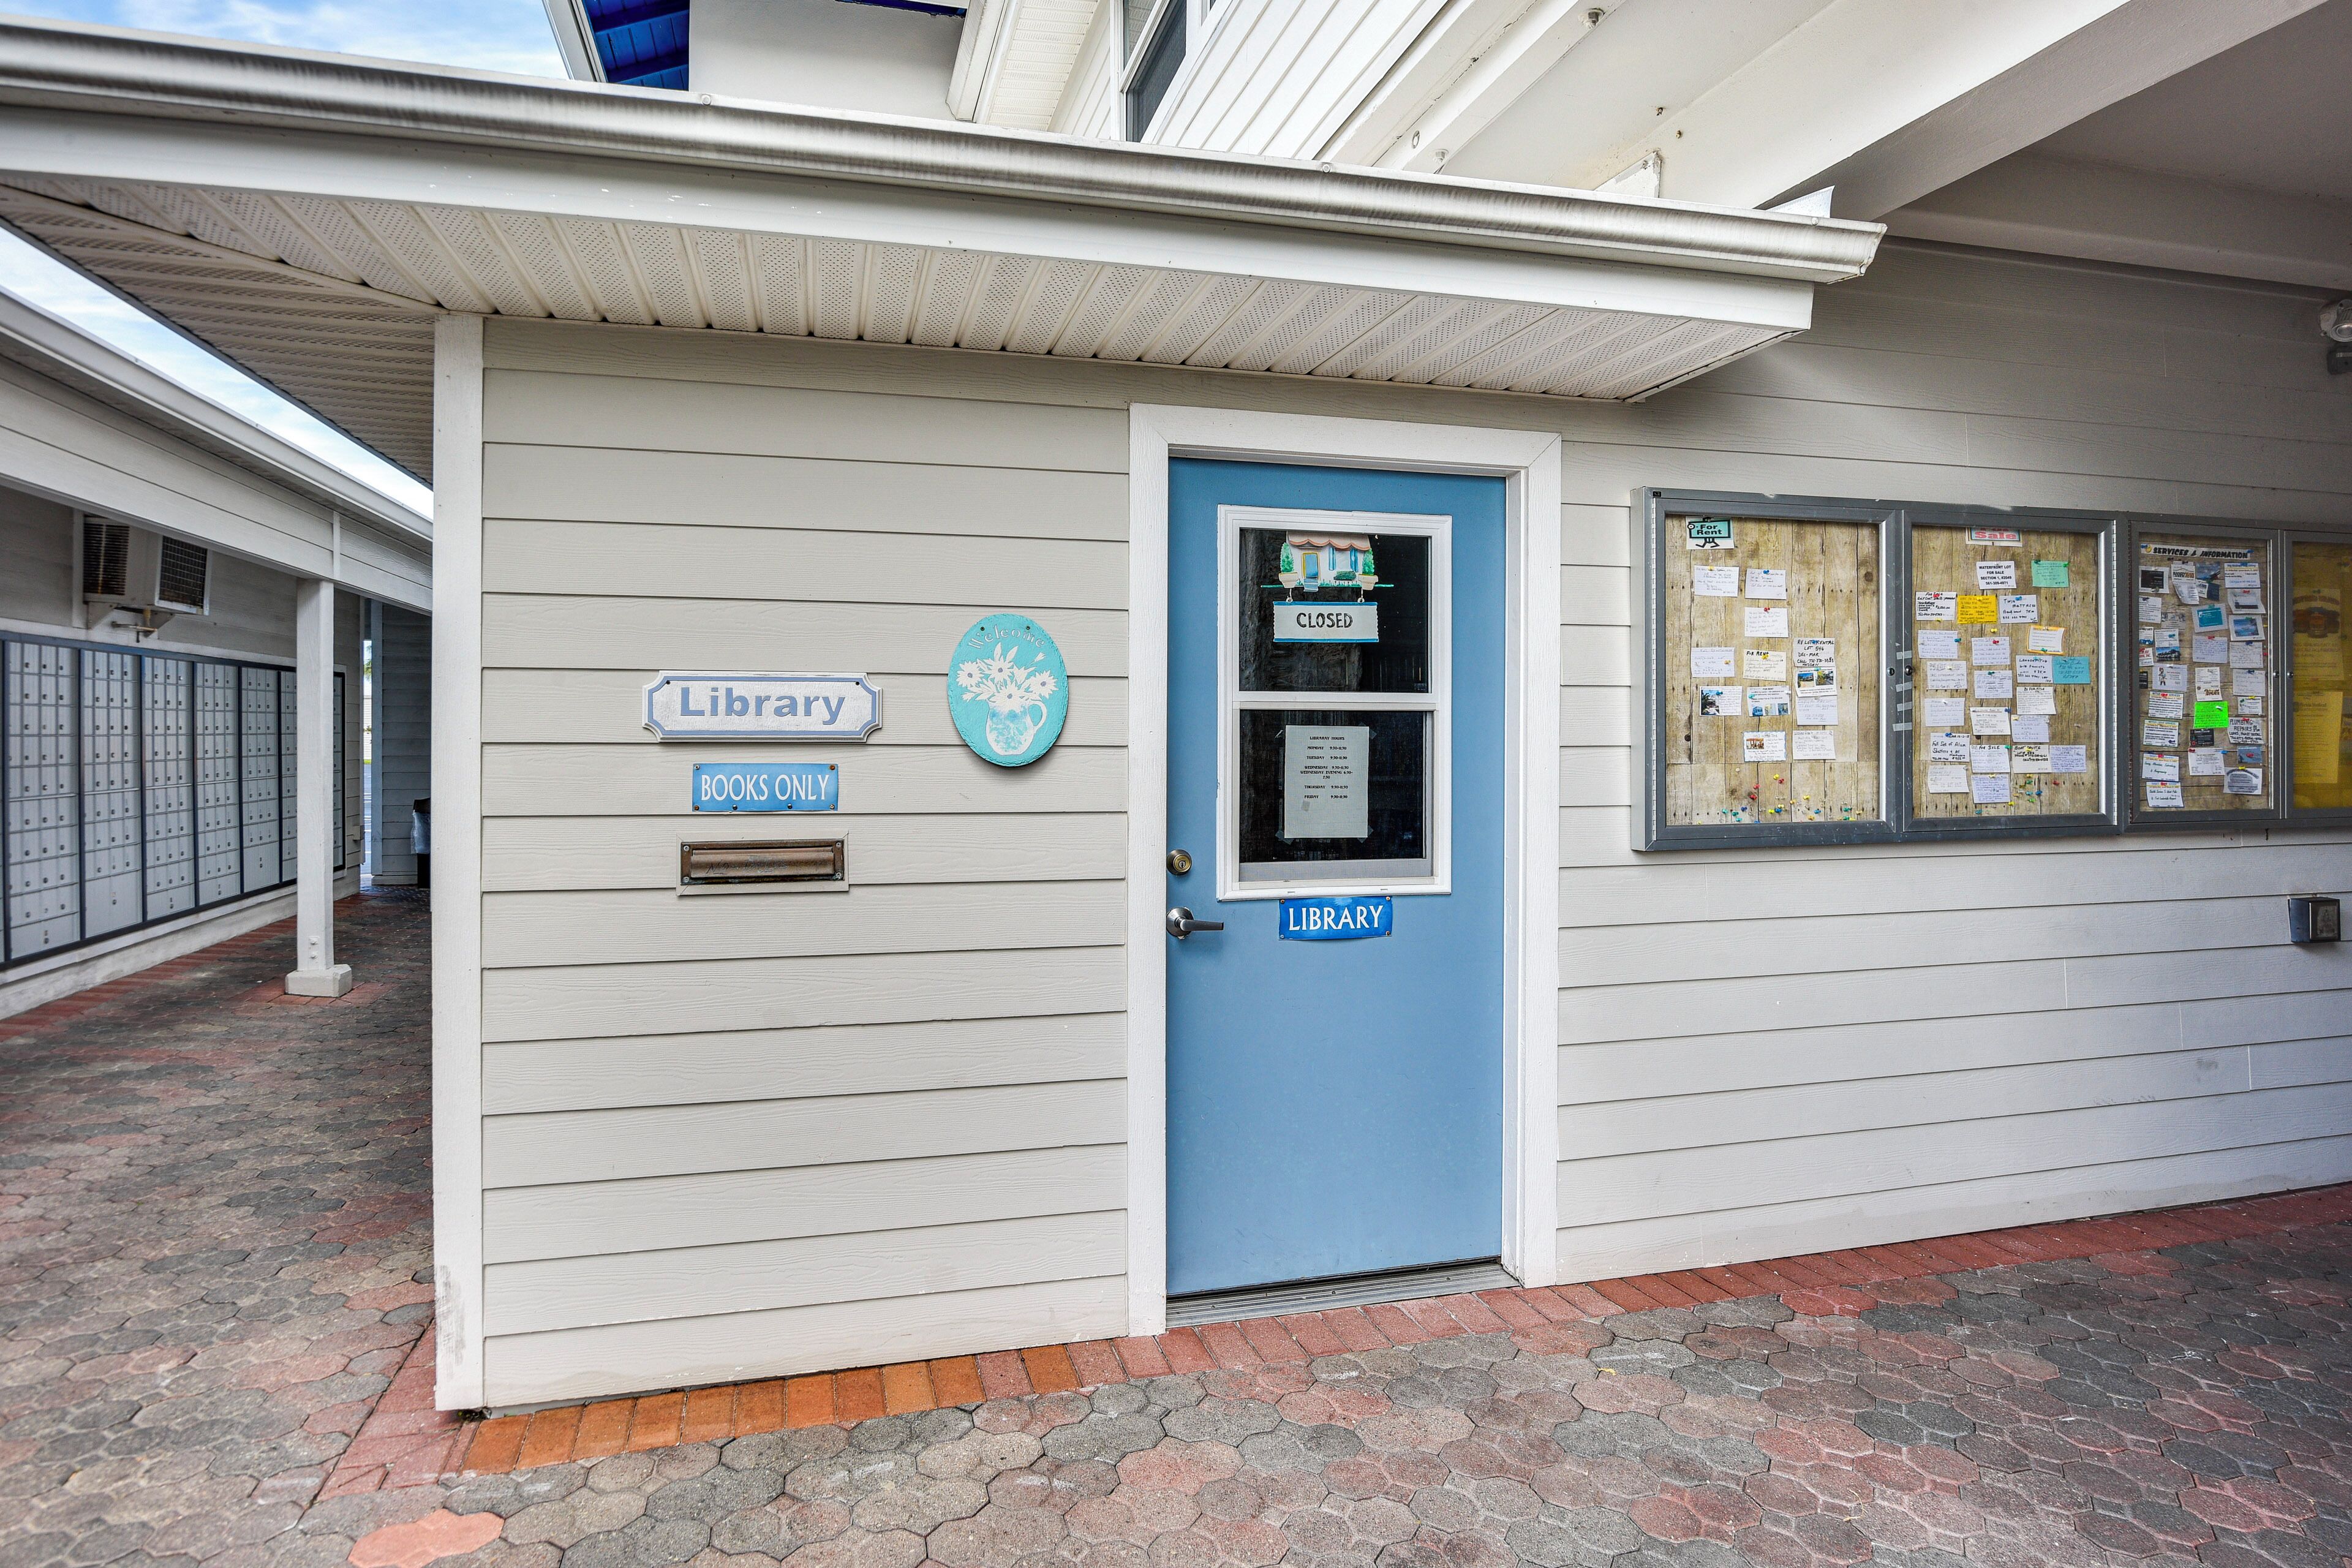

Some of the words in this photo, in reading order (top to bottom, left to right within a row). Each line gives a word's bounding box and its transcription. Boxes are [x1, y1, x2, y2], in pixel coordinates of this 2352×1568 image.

[1975, 531, 2017, 540] Sale
[2153, 547, 2189, 556] SERVICES
[2200, 550, 2248, 559] INFORMATION
[1296, 612, 1353, 628] CLOSED
[968, 624, 1045, 649] Welcome
[680, 687, 845, 725] Library
[701, 774, 768, 801] BOOKS
[775, 774, 829, 801] ONLY
[1289, 905, 1384, 931] LIBRARY
